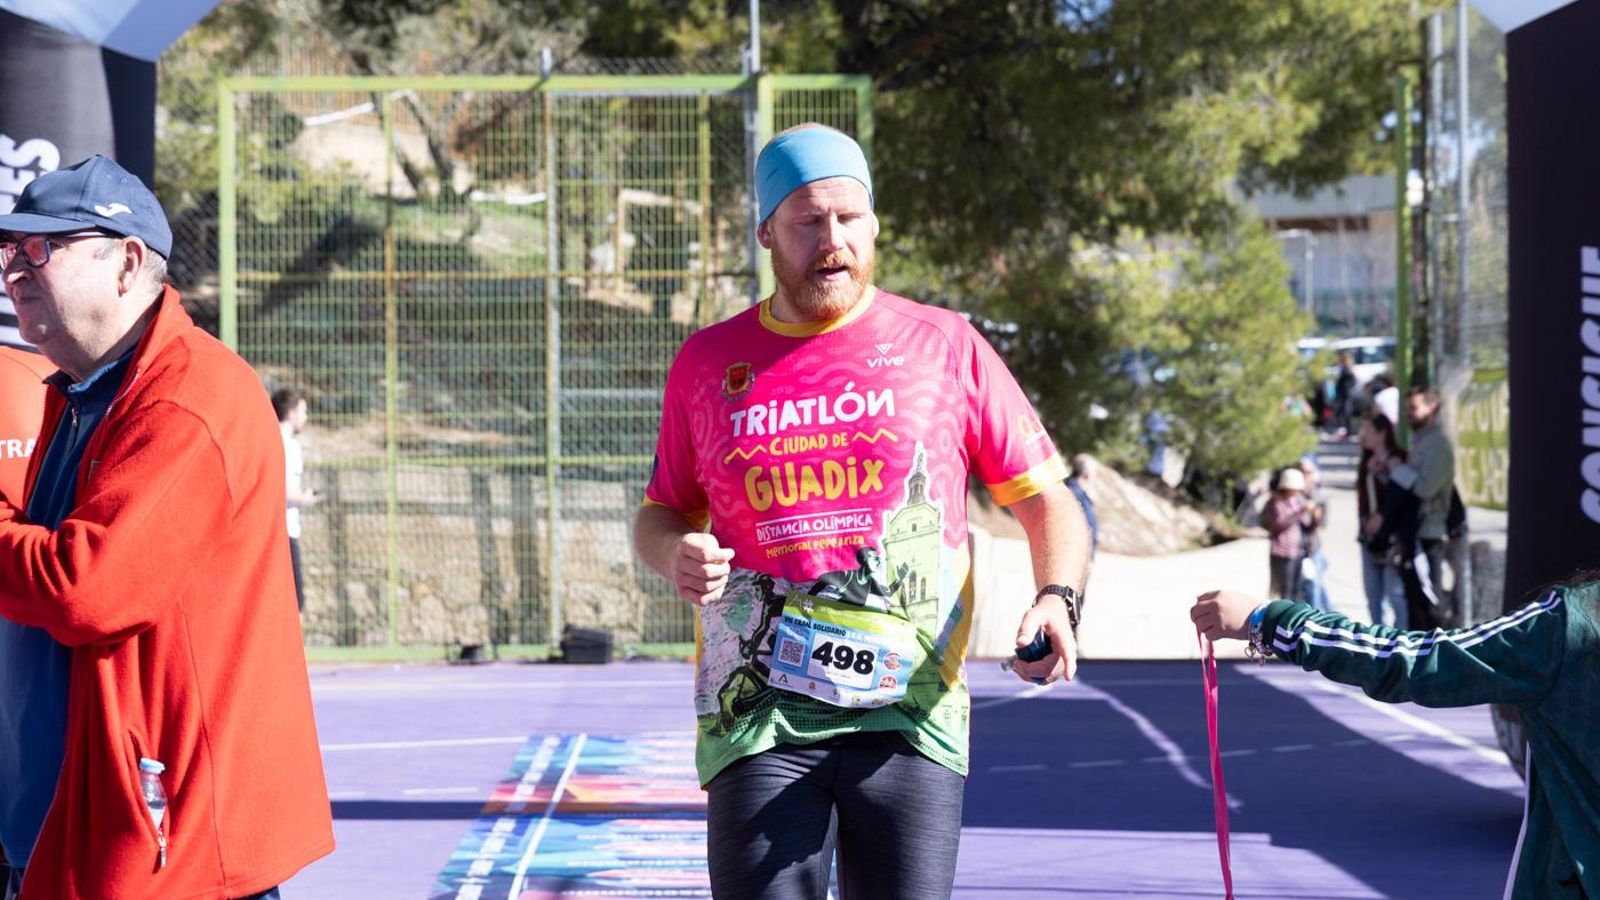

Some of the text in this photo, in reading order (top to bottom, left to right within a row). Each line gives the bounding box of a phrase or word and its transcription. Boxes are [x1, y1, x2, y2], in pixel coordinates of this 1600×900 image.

[866, 355, 905, 368] vive
[832, 432, 850, 448] DE
[811, 641, 875, 675] 498
